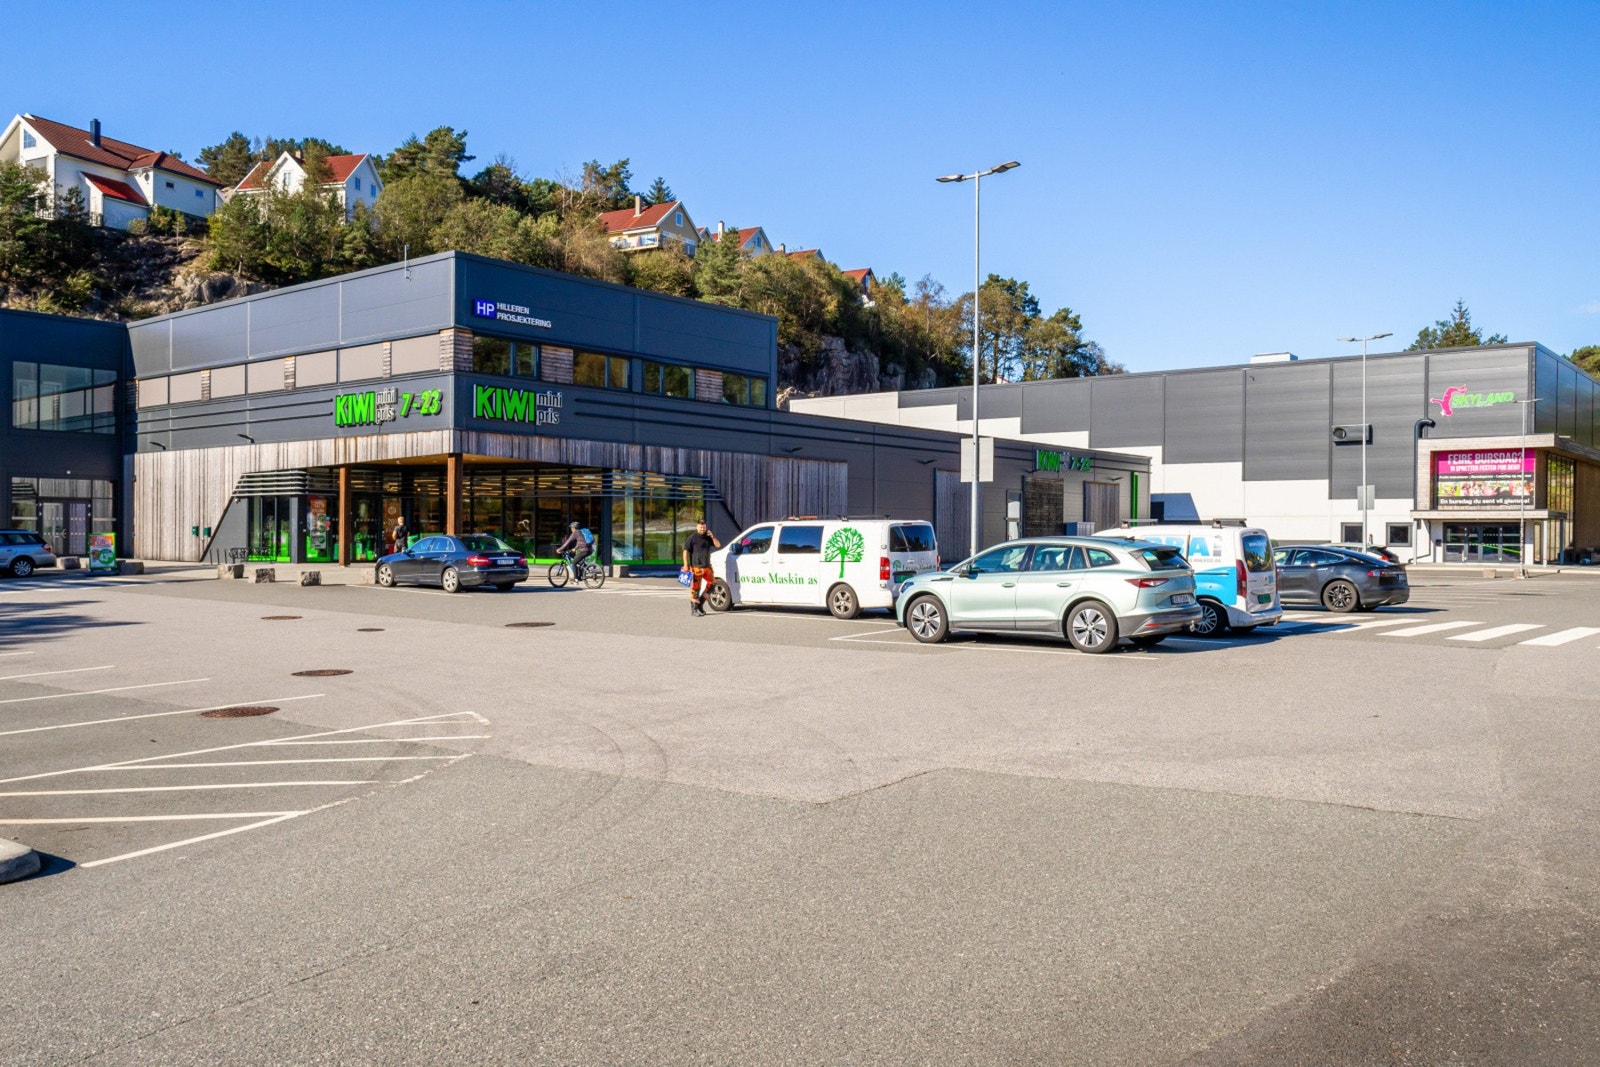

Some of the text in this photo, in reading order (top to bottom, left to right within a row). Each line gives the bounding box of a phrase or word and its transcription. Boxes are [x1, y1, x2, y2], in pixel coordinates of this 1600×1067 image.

[477, 301, 495, 316] HP
[496, 302, 530, 314] HILLEREN
[496, 312, 552, 328] PROSJEKTERING
[376, 387, 398, 405] mini
[473, 384, 536, 422] KIWI
[537, 391, 563, 408] mini
[335, 391, 376, 427] KIWI
[376, 405, 397, 424] pris
[536, 408, 561, 425] pris
[1447, 453, 1473, 465] FEIRE
[734, 572, 818, 585] Lovaas Maskin as
